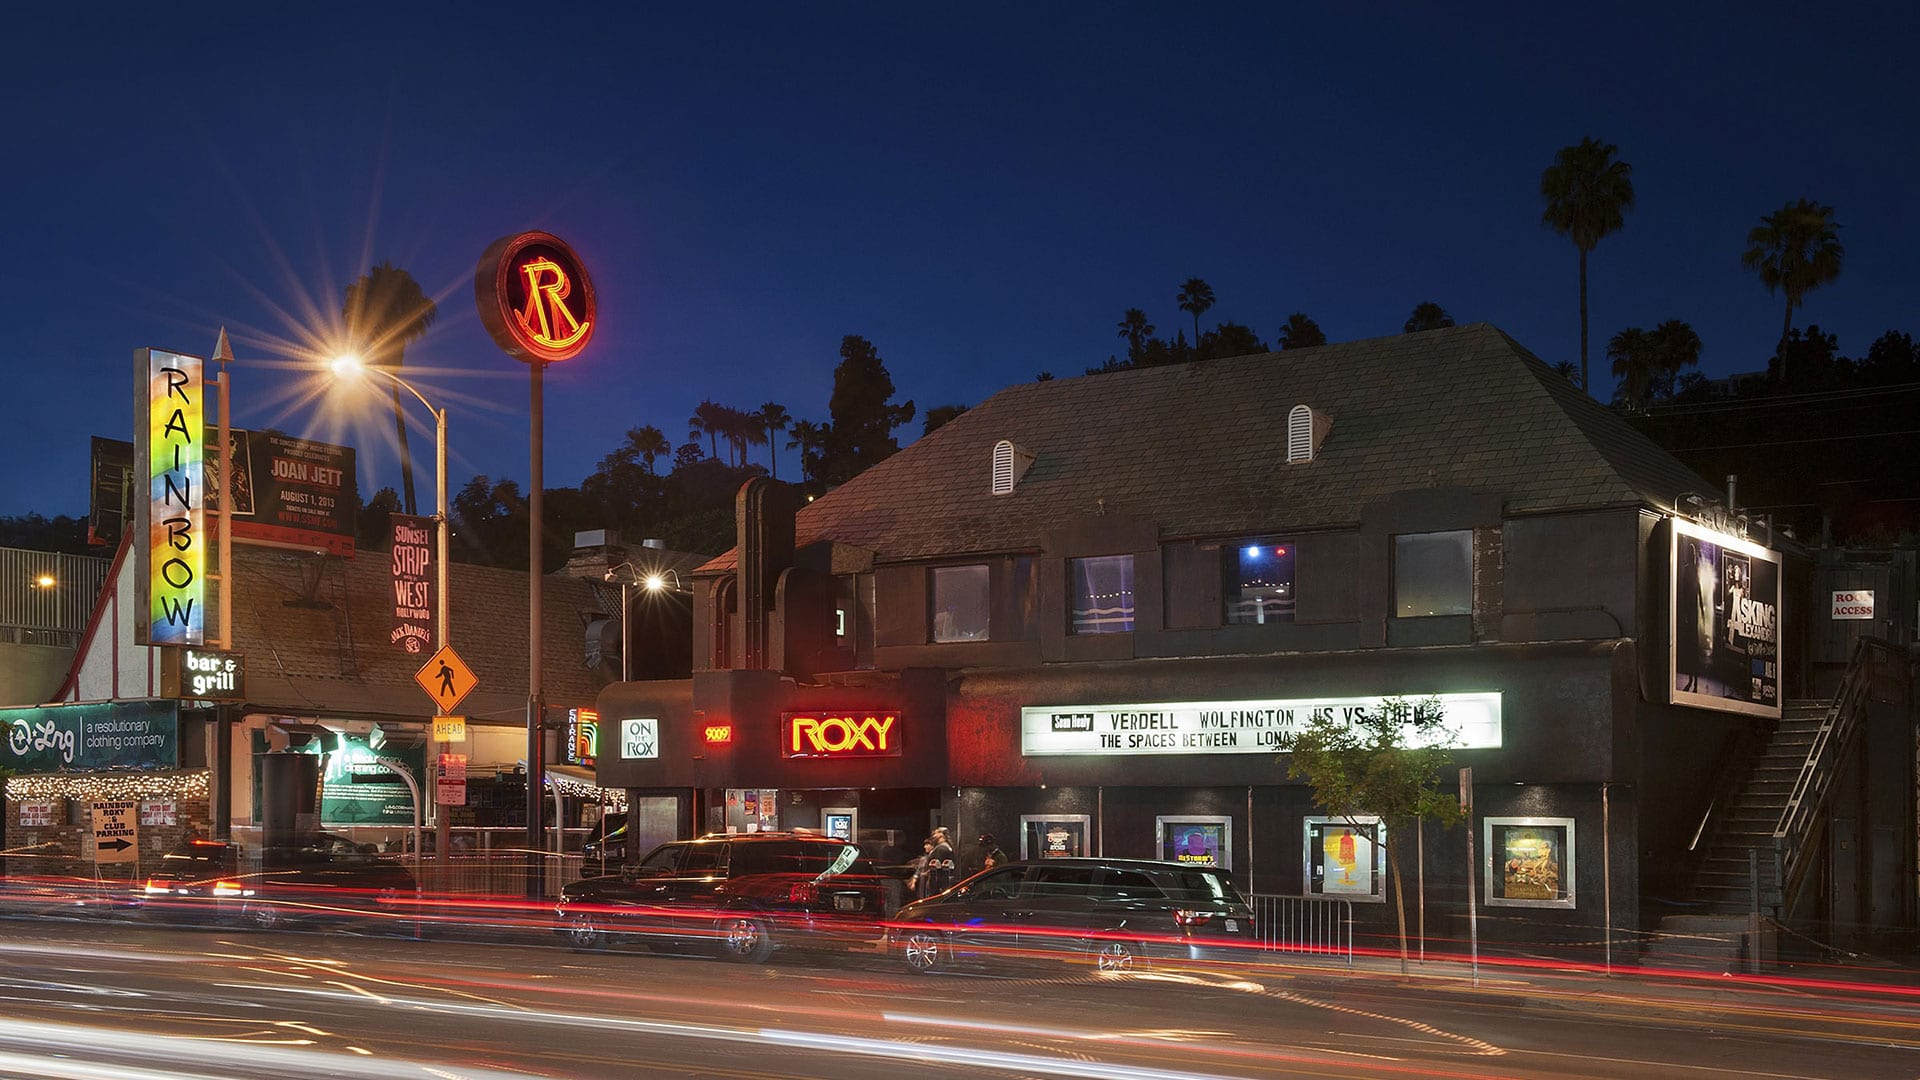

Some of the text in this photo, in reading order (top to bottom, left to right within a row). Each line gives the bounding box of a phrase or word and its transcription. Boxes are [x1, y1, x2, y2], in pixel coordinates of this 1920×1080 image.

[271, 459, 343, 487] JOAN JETT
[160, 367, 194, 627] RAINBOW
[280, 490, 335, 508] AUGUST 1, 2013
[395, 525, 429, 545] SUNSET
[392, 544, 430, 577] STRIP
[394, 580, 430, 608] WEST
[396, 607, 430, 620] HOLLYWOOD
[1731, 597, 1776, 628] ASKING
[1834, 606, 1873, 616] ACCESS
[390, 627, 405, 644] JACK
[186, 650, 237, 672] bar &
[192, 671, 235, 696] grill
[86, 720, 151, 734] a resolutionary
[1111, 712, 1179, 731] VERDELL
[1200, 708, 1294, 728] WOLFINGTON
[435, 723, 463, 735] AHEAD
[568, 708, 577, 762] ENTRANCE
[629, 722, 652, 736] ON
[704, 727, 729, 741] 9009
[793, 717, 895, 752] ROXY
[86, 734, 165, 750] clothing company
[627, 742, 656, 756] ROX
[1100, 734, 1122, 749] THE
[1129, 733, 1176, 749] SPACES
[1183, 732, 1237, 748] BETWEEN
[93, 801, 134, 810] RAINBOW
[96, 829, 134, 838] PARKING
